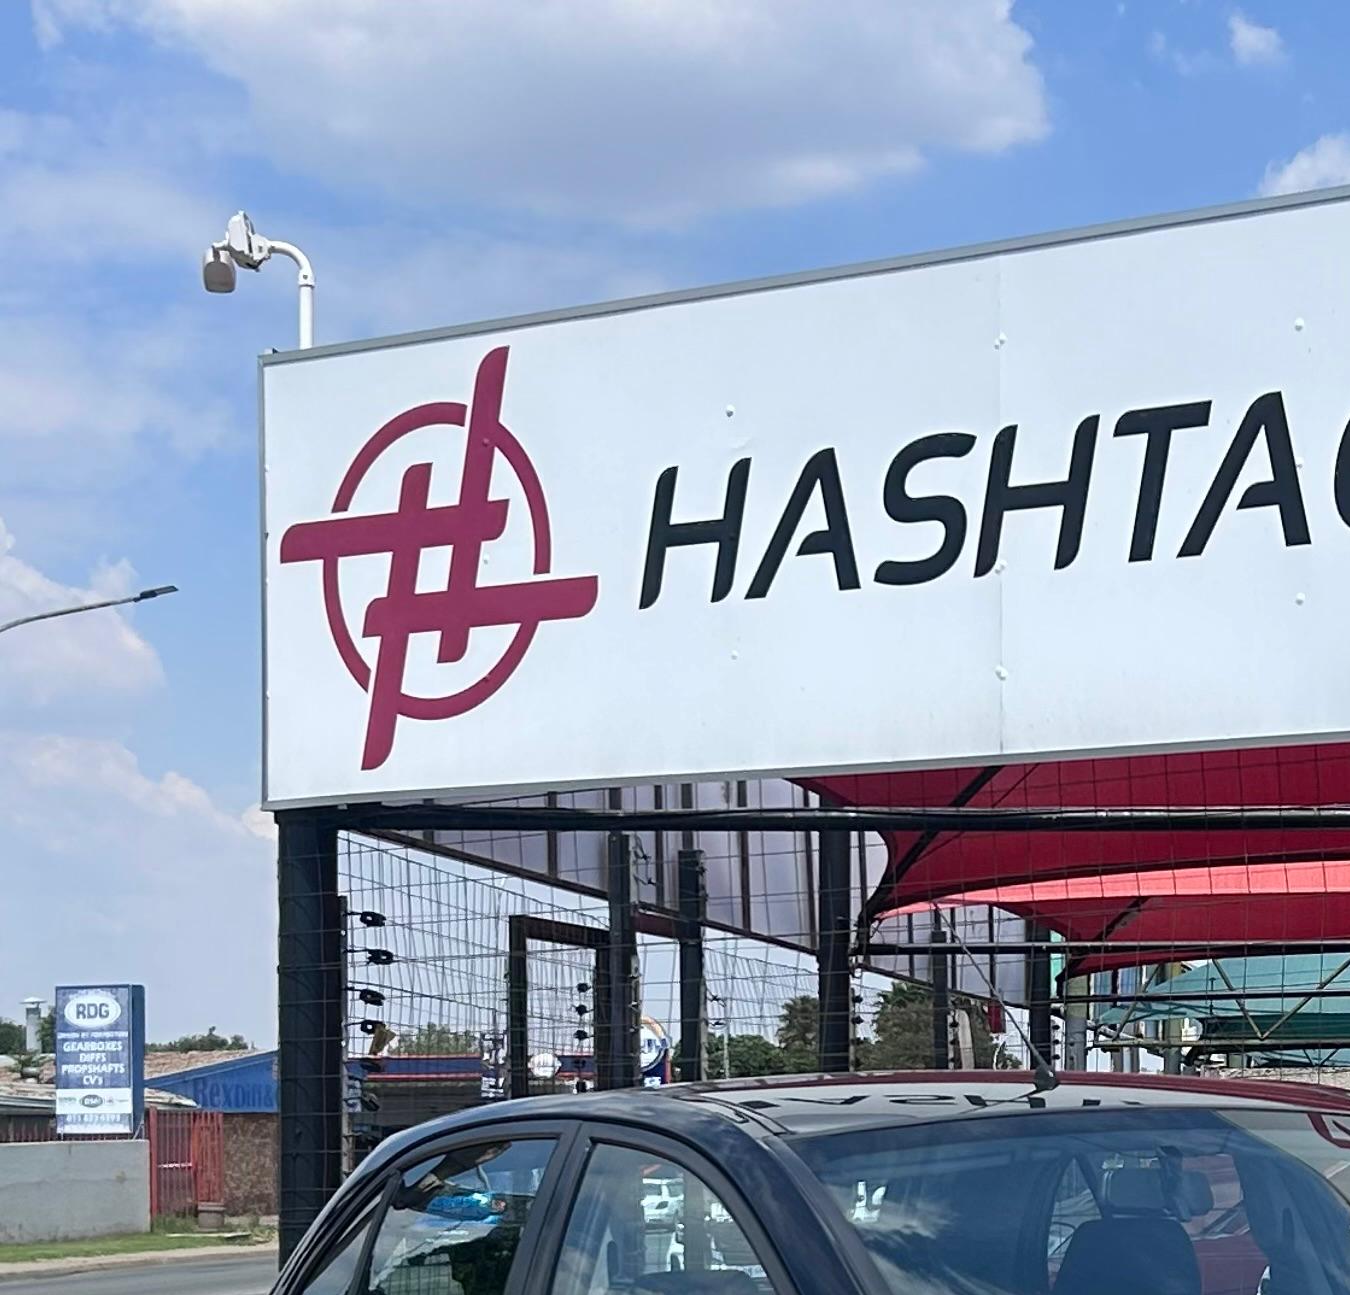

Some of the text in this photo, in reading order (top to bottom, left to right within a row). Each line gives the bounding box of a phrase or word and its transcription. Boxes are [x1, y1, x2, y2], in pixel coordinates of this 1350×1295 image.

[76, 1003, 110, 1019] RDG
[63, 1041, 122, 1053] GEARBOXES
[79, 1053, 106, 1063] DIFFS
[61, 1063, 125, 1074] PROPSHAFTS
